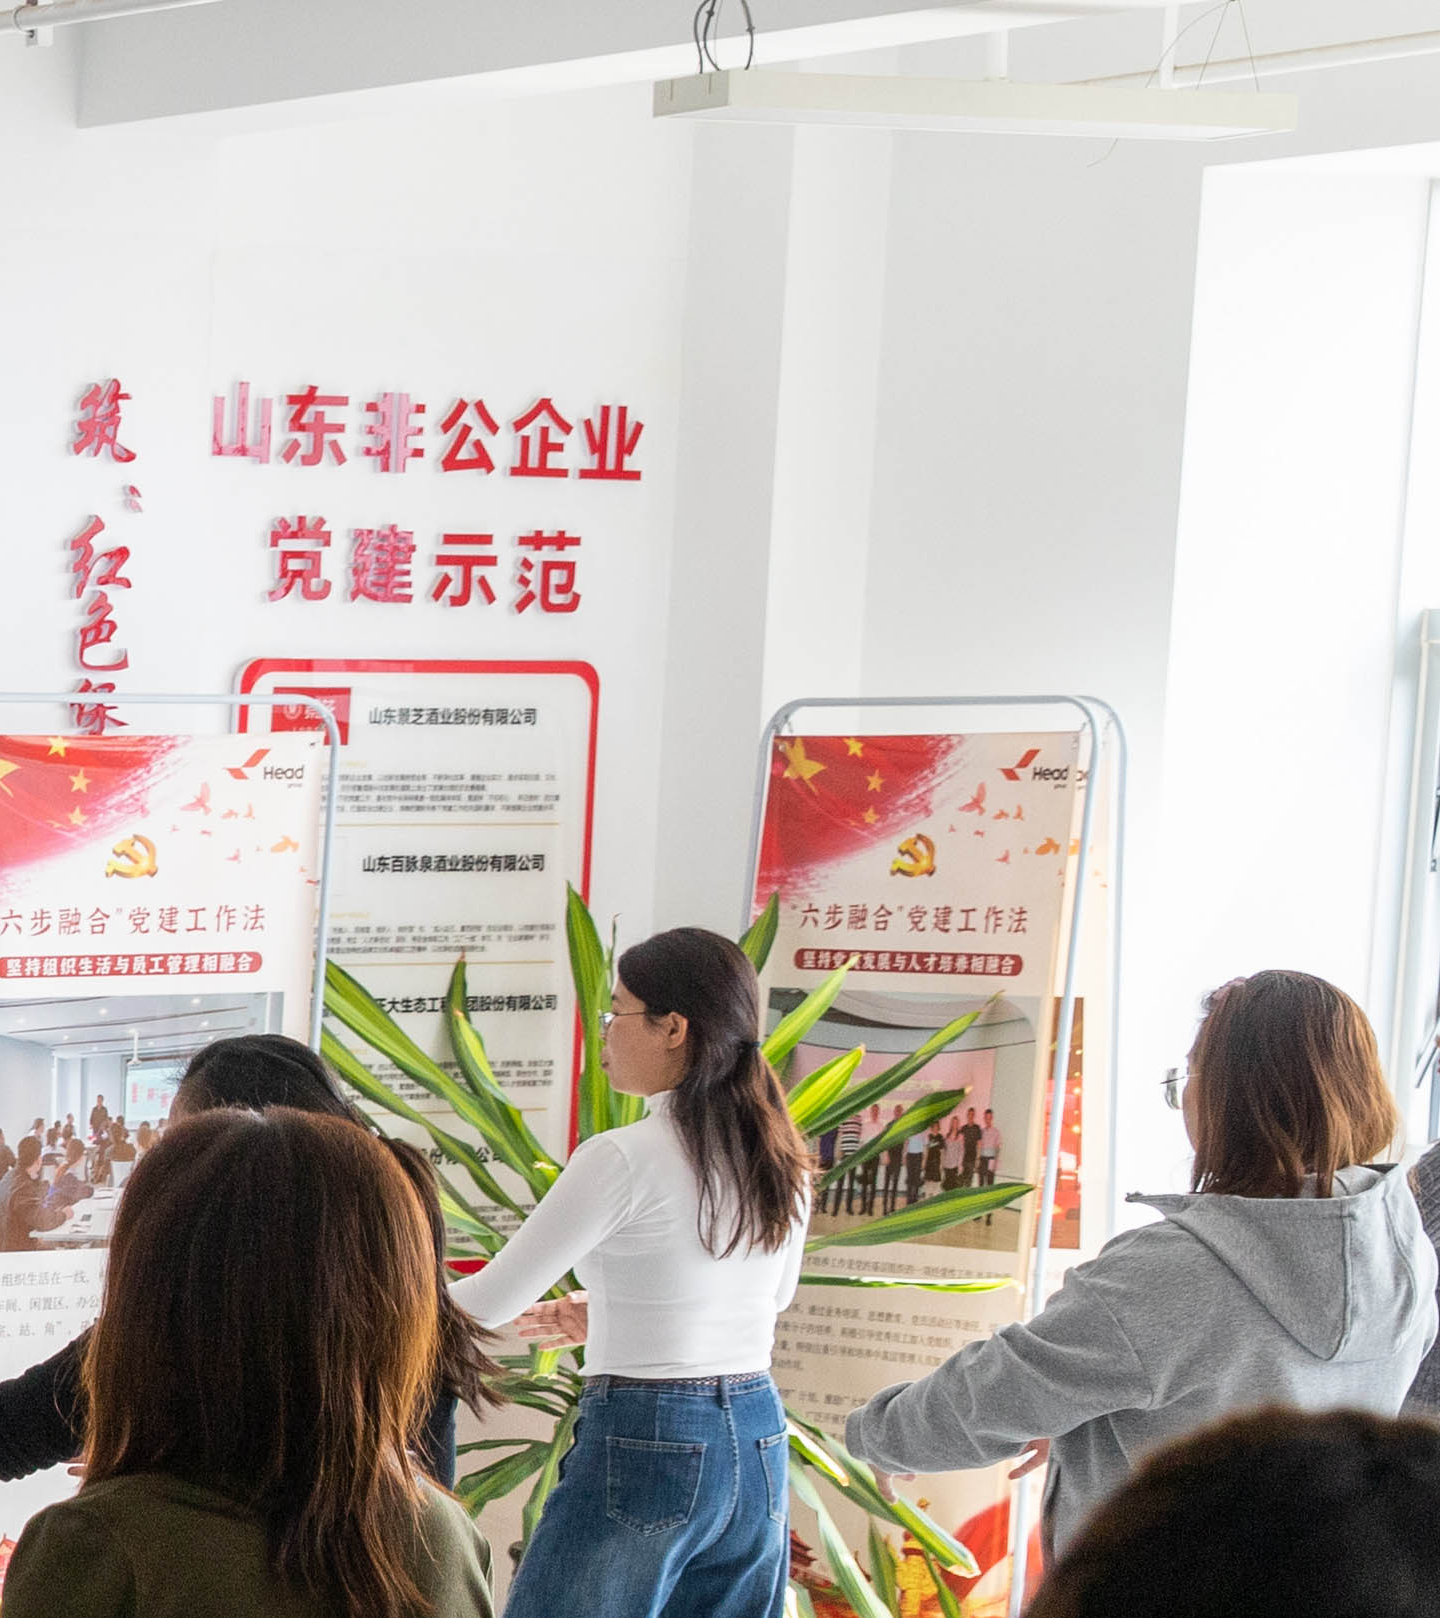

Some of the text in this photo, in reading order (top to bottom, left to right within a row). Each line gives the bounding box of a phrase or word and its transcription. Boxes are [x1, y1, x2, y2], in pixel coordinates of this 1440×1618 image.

[212, 381, 645, 481] 山东非公企业
[268, 515, 583, 613] 党建示范
[368, 707, 537, 726] 山东景芝酒业股份有限公司
[263, 765, 304, 780] Head
[1032, 764, 1069, 780] Head
[5, 953, 252, 976] 坚持组织生活与员工管理相融合
